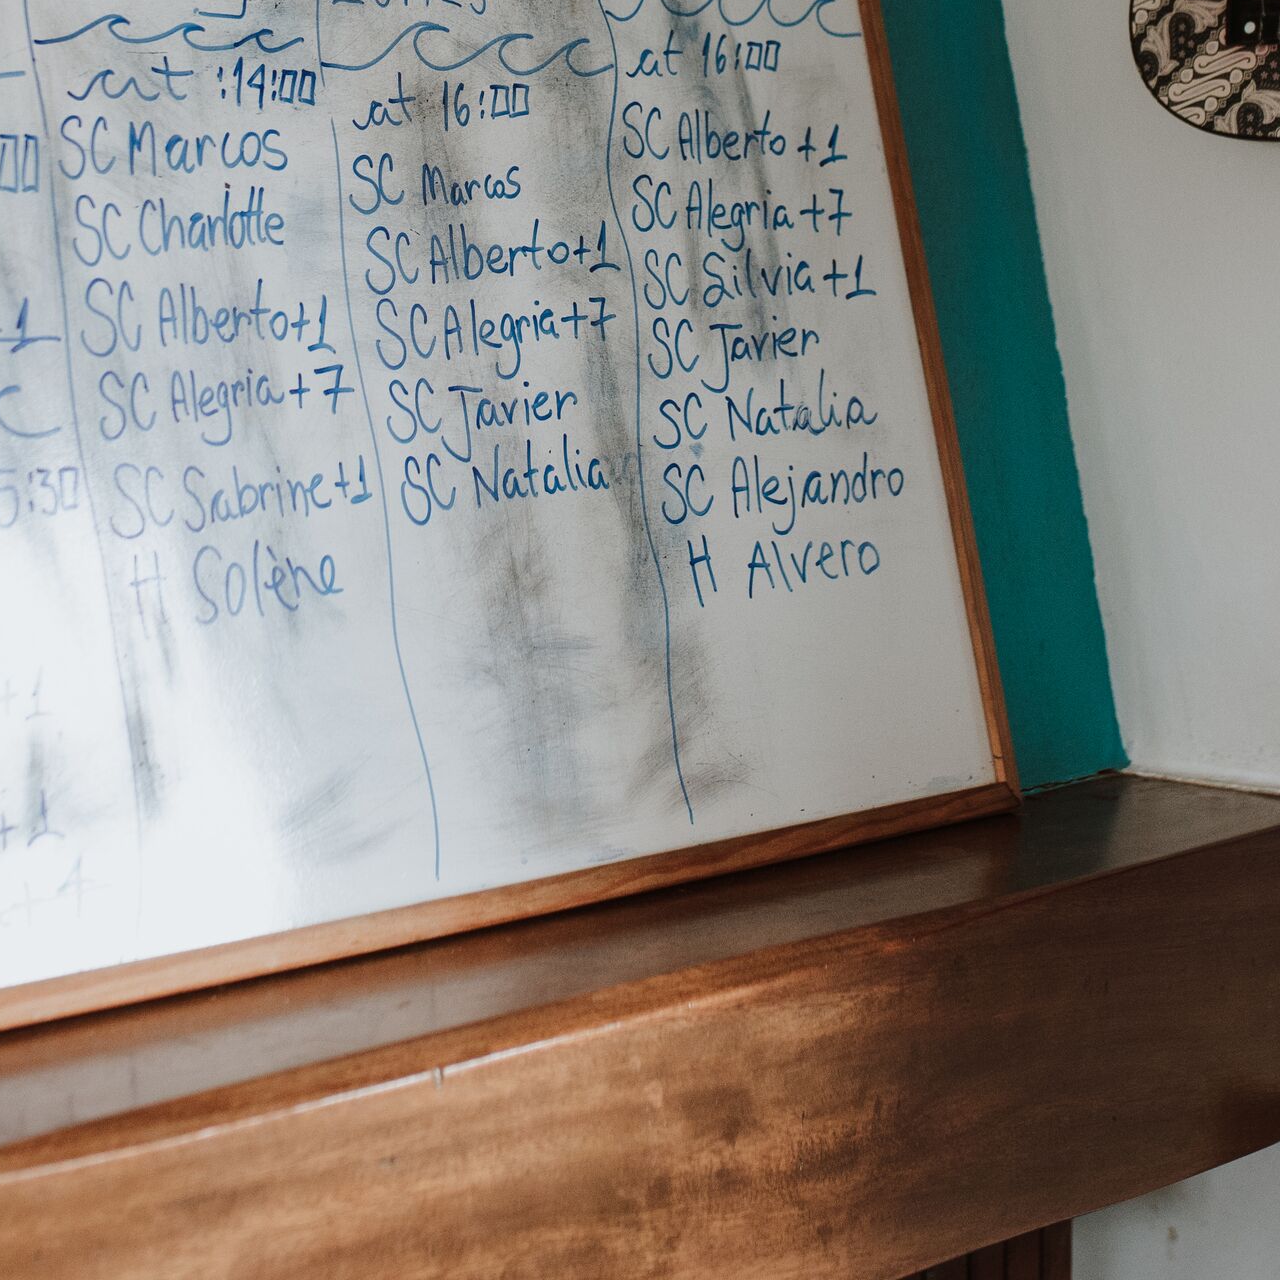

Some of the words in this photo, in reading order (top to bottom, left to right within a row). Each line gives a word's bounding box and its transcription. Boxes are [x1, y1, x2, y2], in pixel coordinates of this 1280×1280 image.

[67, 55, 193, 101] at
[626, 29, 683, 78] at
[702, 31, 781, 78] 16:00
[353, 72, 416, 130] at
[443, 80, 530, 131] 16:00
[622, 101, 670, 160] SC
[58, 115, 116, 180] SC
[129, 121, 288, 177] Marcos
[349, 153, 404, 214] SC
[421, 163, 521, 206] Marcos
[73, 194, 131, 267] SC
[139, 185, 285, 257] Charlotte
[632, 174, 677, 232] SC
[366, 226, 419, 295] SC
[644, 248, 689, 310] SC
[81, 278, 142, 357] SC
[376, 298, 436, 370] SC
[648, 317, 699, 379] SC
[701, 315, 820, 393] Javier
[98, 370, 157, 441] SC
[387, 378, 442, 444] SC
[441, 380, 578, 463] Javier
[654, 392, 708, 449] SC
[725, 368, 878, 441] Natalia
[110, 463, 174, 539] SC
[401, 453, 456, 526] SC
[472, 433, 609, 509] Natalia
[662, 463, 714, 525] SC
[732, 451, 904, 536] Alejandro
[129, 550, 168, 632] H
[687, 534, 718, 607] H
[747, 540, 880, 598] Alvero
